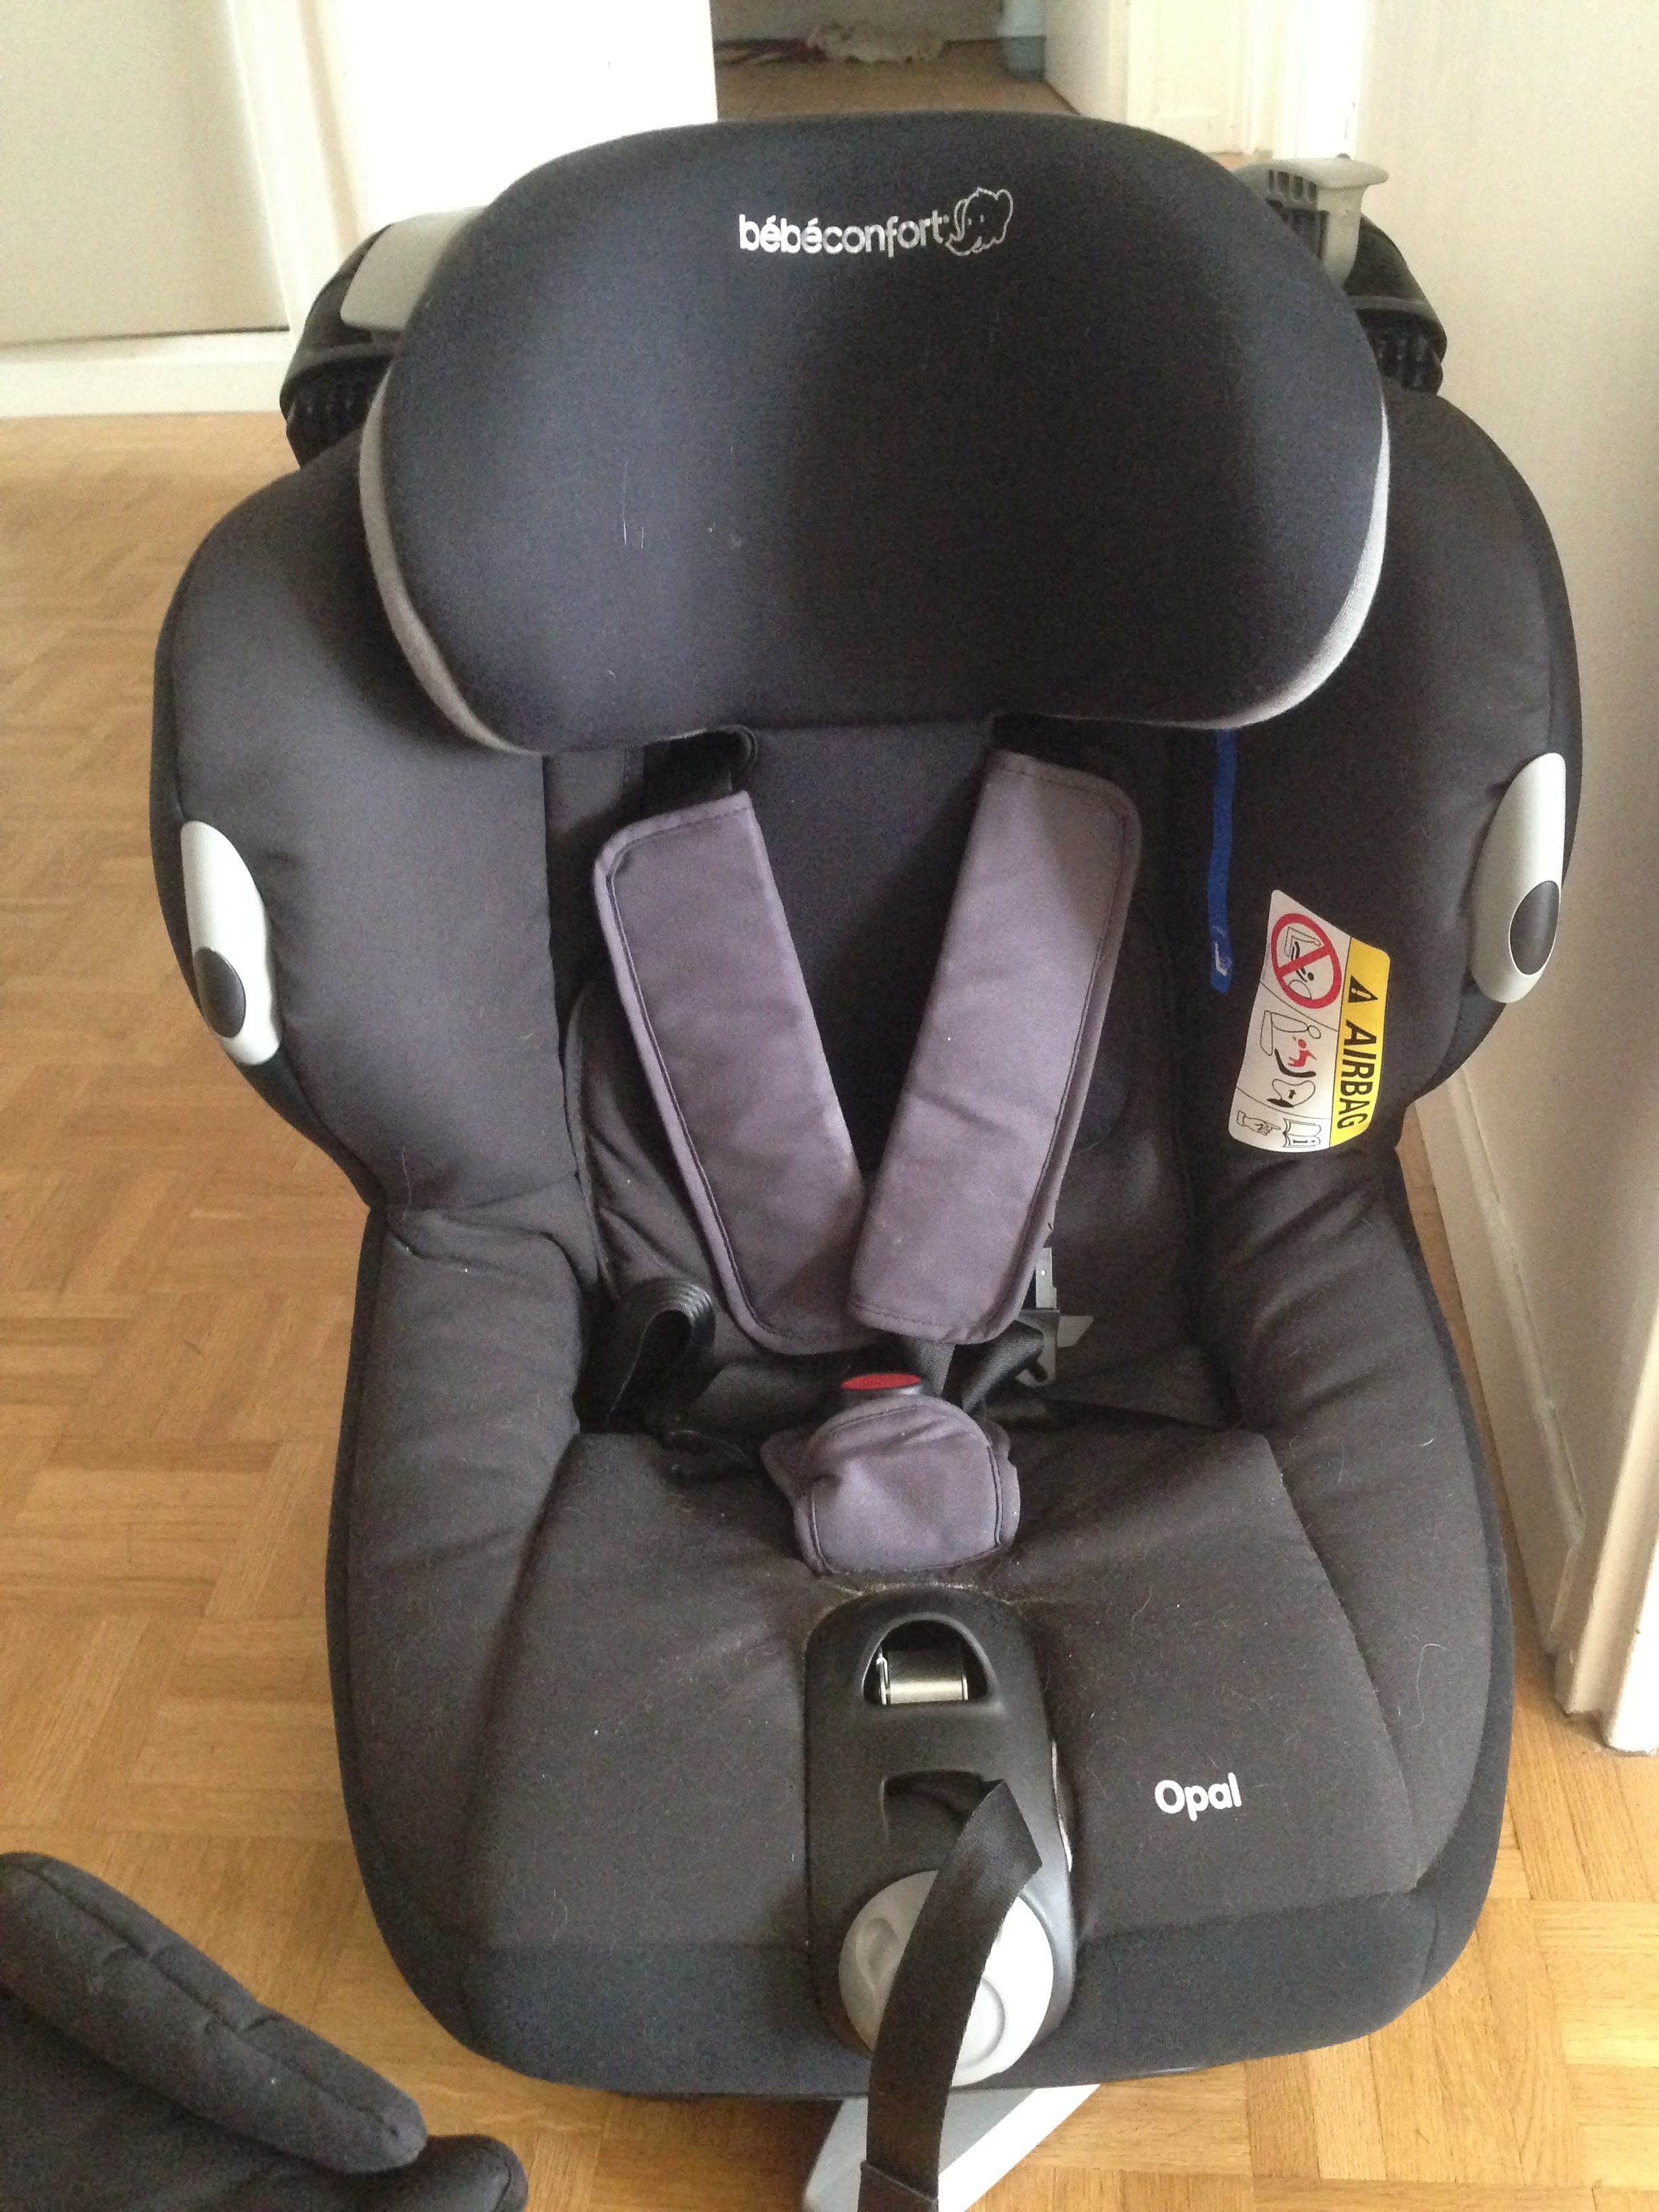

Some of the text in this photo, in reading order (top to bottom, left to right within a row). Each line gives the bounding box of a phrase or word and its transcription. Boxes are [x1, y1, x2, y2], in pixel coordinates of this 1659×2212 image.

[739, 210, 944, 258] bébéconfort
[1336, 1019, 1377, 1129] AIRBAG
[1154, 1771, 1242, 1822] Opal
